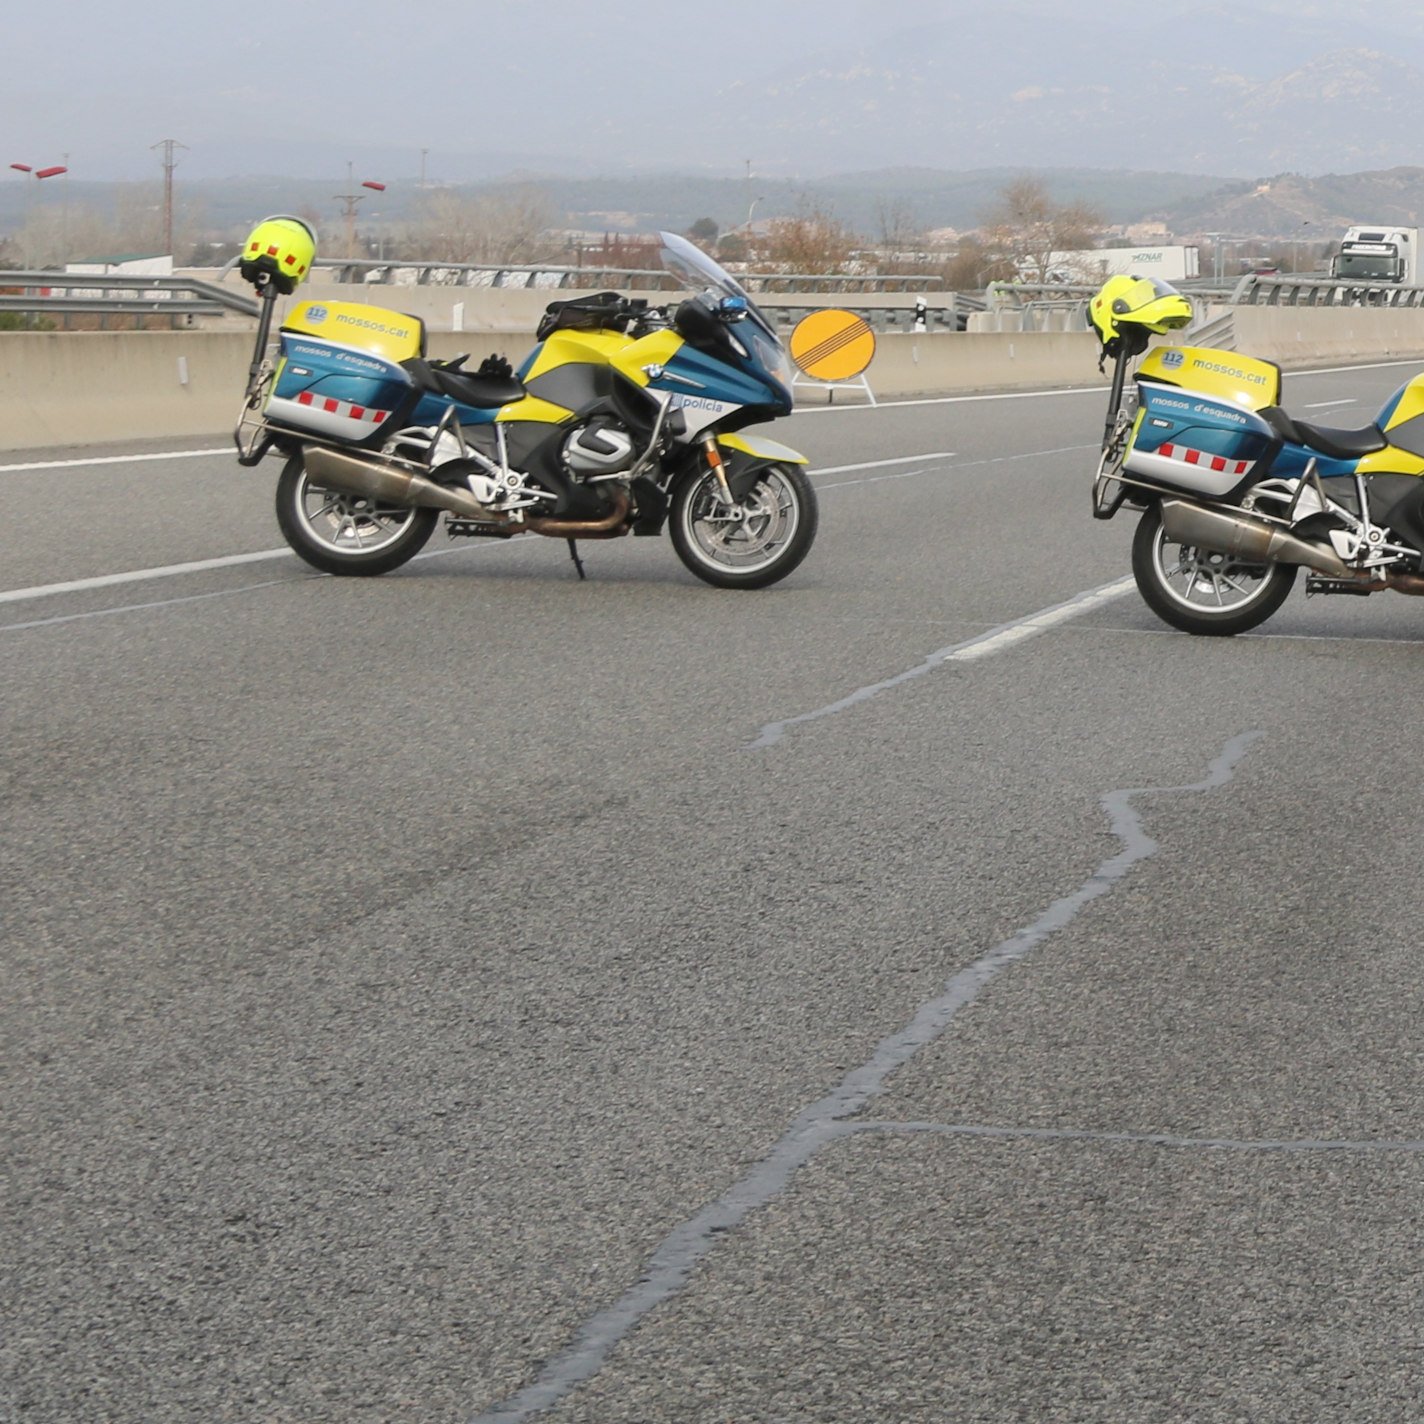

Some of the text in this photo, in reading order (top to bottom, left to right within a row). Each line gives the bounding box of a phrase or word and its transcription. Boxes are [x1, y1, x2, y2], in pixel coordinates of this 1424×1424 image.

[308, 307, 327, 318] 112
[336, 313, 409, 339] mossos.cat
[295, 345, 388, 372] mossos d'esquadra
[1163, 352, 1184, 363] 112
[1193, 358, 1267, 385] mossos.cat
[1152, 396, 1247, 424] mossos d'esquadra
